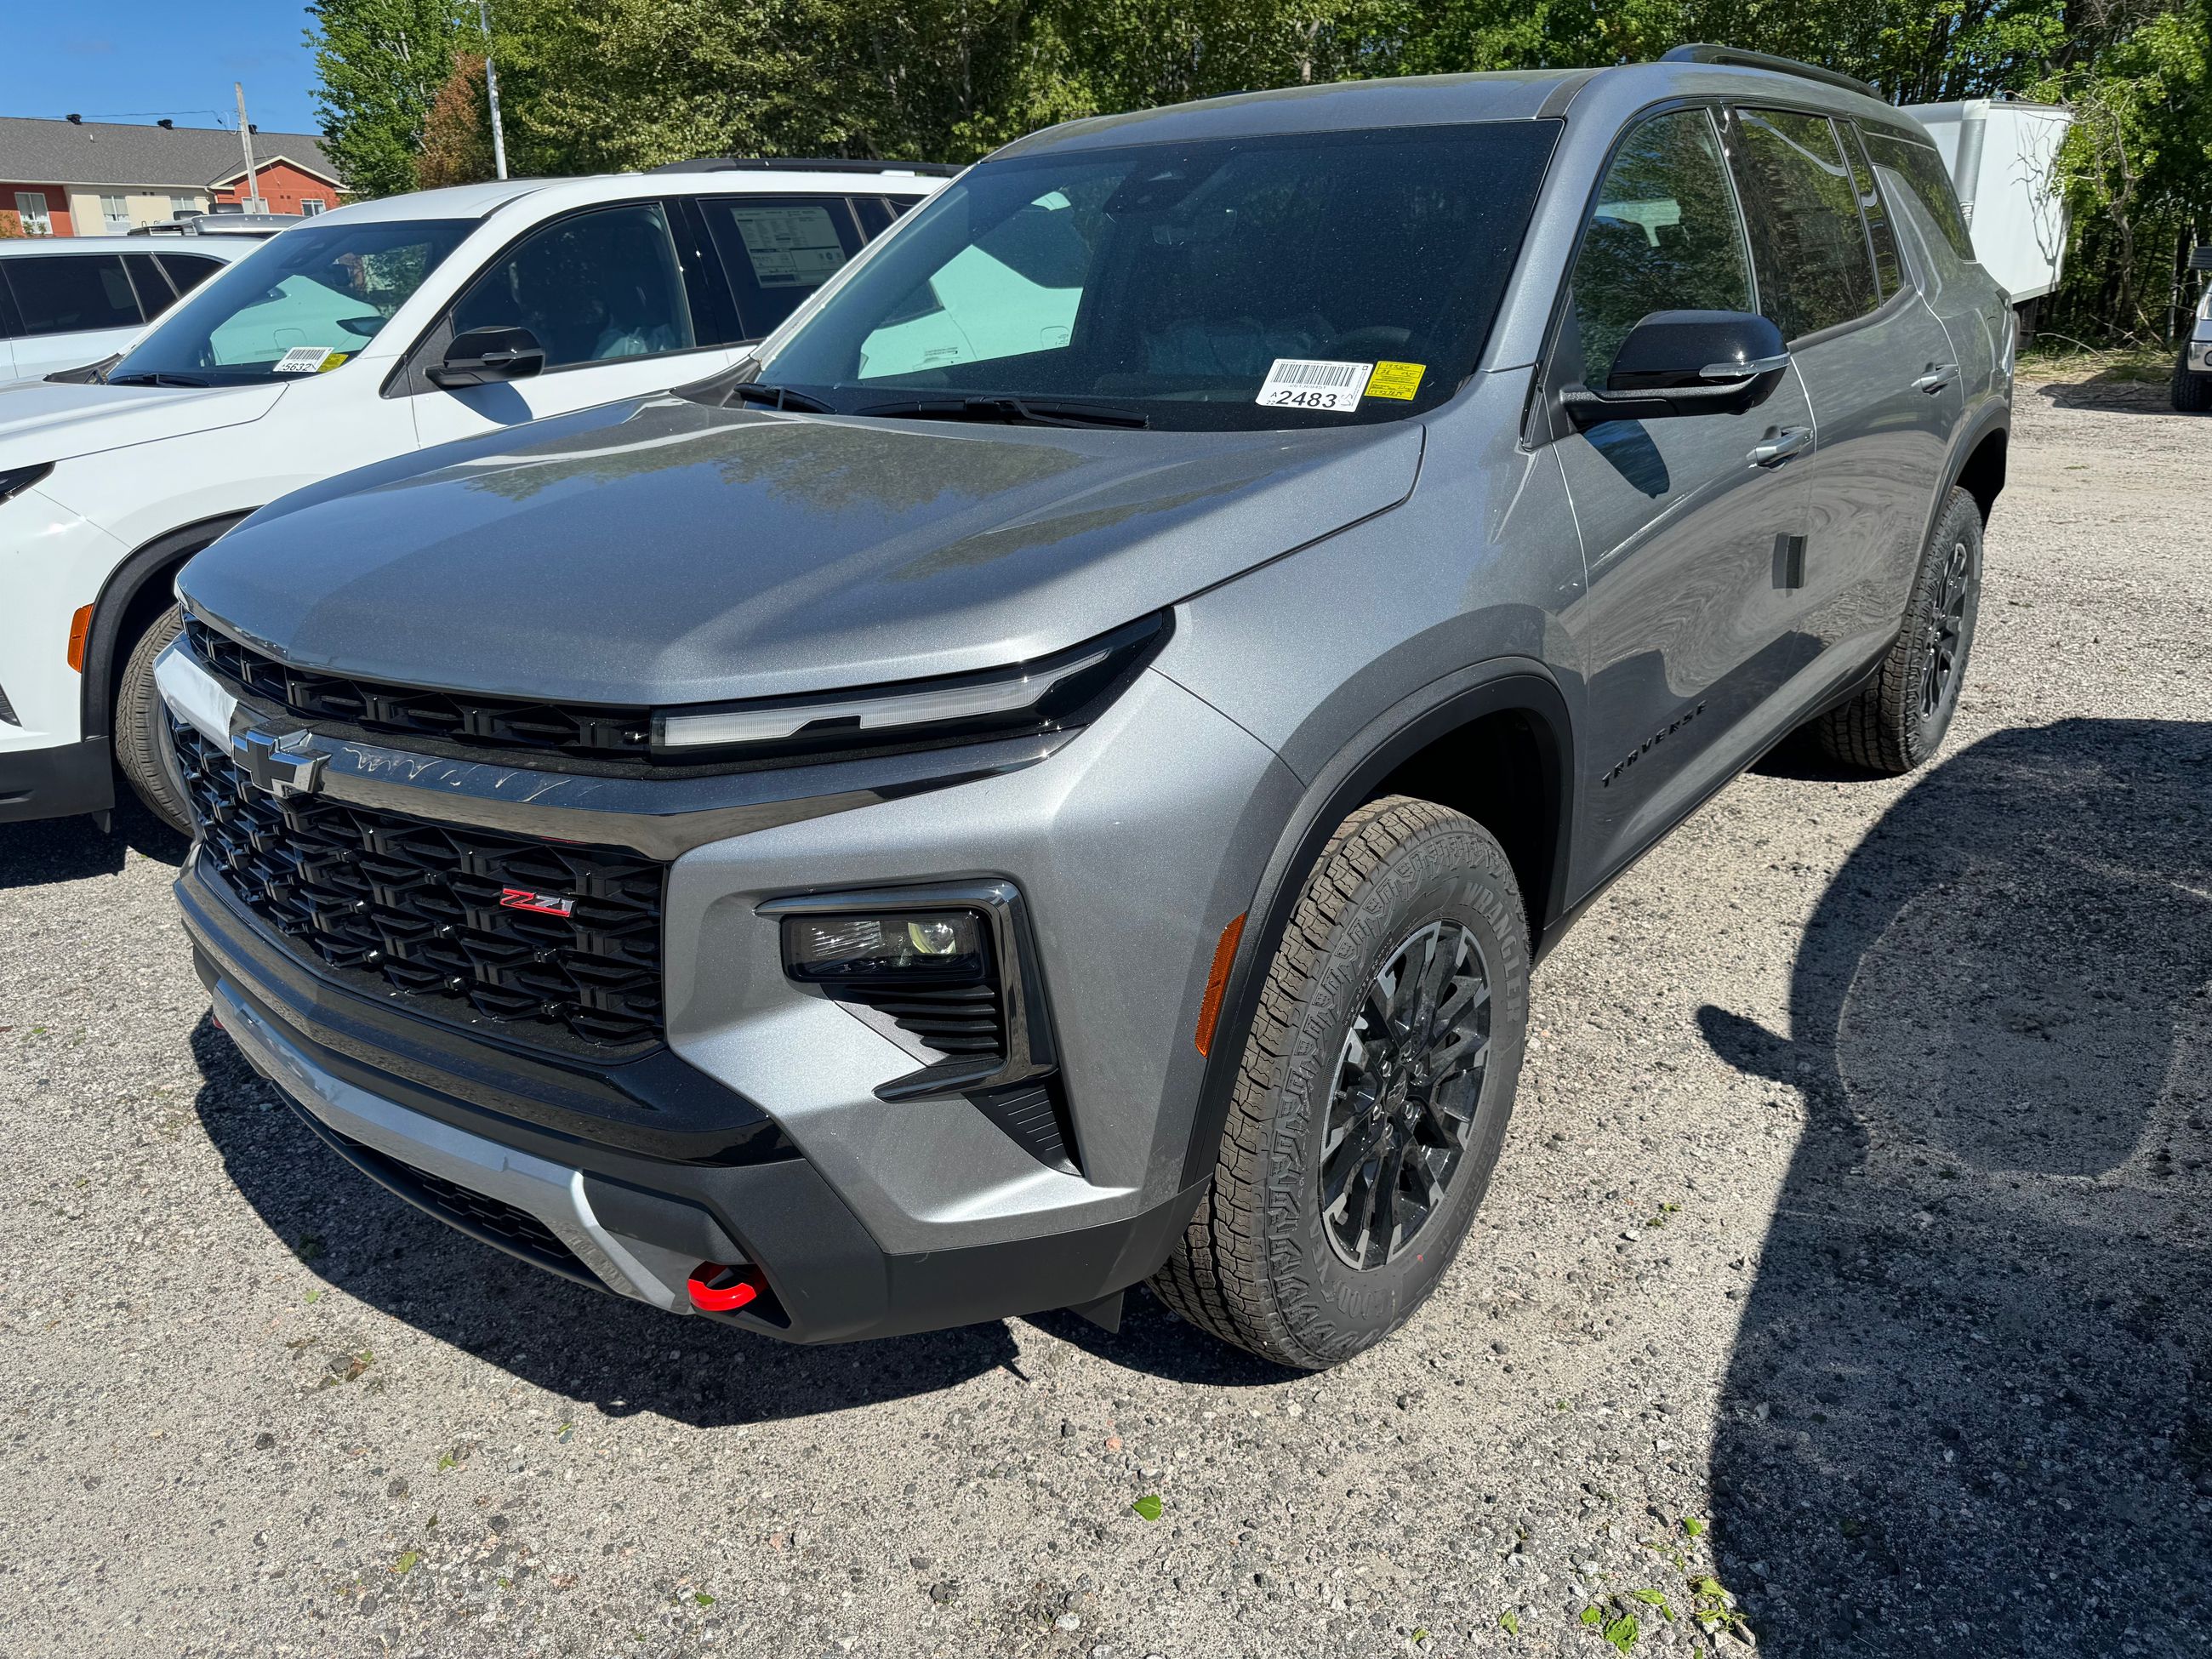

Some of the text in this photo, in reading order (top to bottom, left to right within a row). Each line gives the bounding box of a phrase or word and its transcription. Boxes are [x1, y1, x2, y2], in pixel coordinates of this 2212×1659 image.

[282, 362, 312, 372] 5632
[1275, 390, 1337, 408] 2483
[499, 887, 576, 918] Z71
[1462, 881, 1523, 1023] WRANGLER
